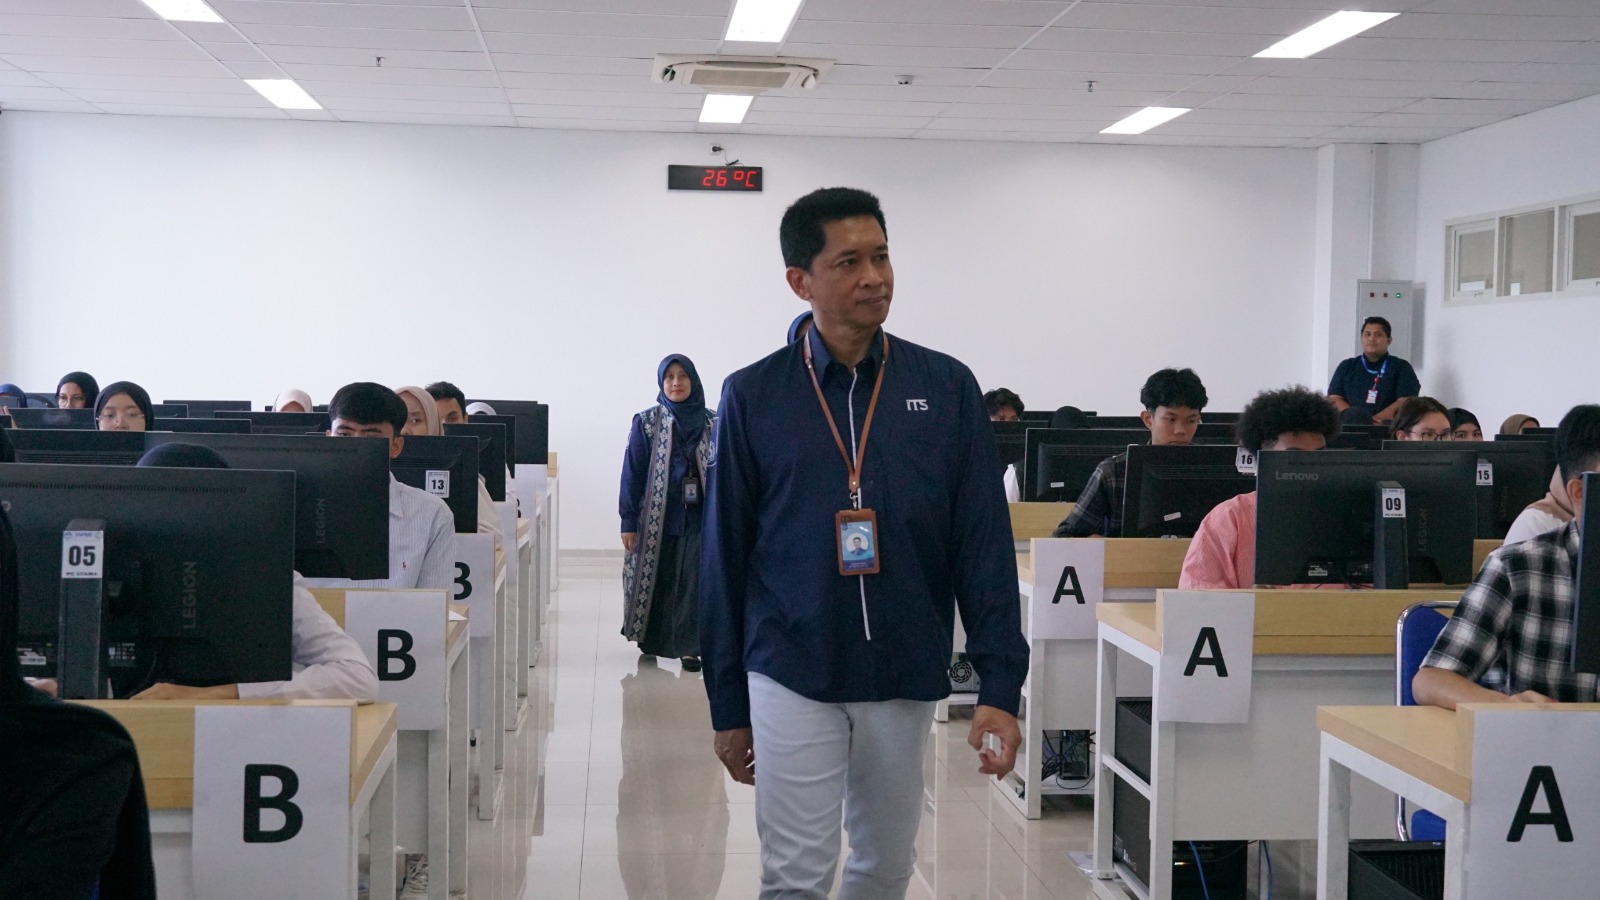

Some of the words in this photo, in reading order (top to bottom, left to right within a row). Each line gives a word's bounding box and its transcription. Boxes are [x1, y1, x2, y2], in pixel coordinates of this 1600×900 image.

[702, 170, 728, 188] 26
[1241, 454, 1253, 465] 16
[431, 479, 445, 490] 13
[1275, 470, 1320, 481] Lenovo
[1477, 470, 1490, 480] 15
[1385, 497, 1402, 511] 09
[315, 498, 326, 544] LEGION
[68, 545, 96, 567] 05
[182, 561, 197, 629] LEGION
[1052, 566, 1086, 605] A
[377, 629, 417, 681] B
[1183, 626, 1229, 678] A
[243, 763, 304, 843] B
[1506, 765, 1574, 843] A
